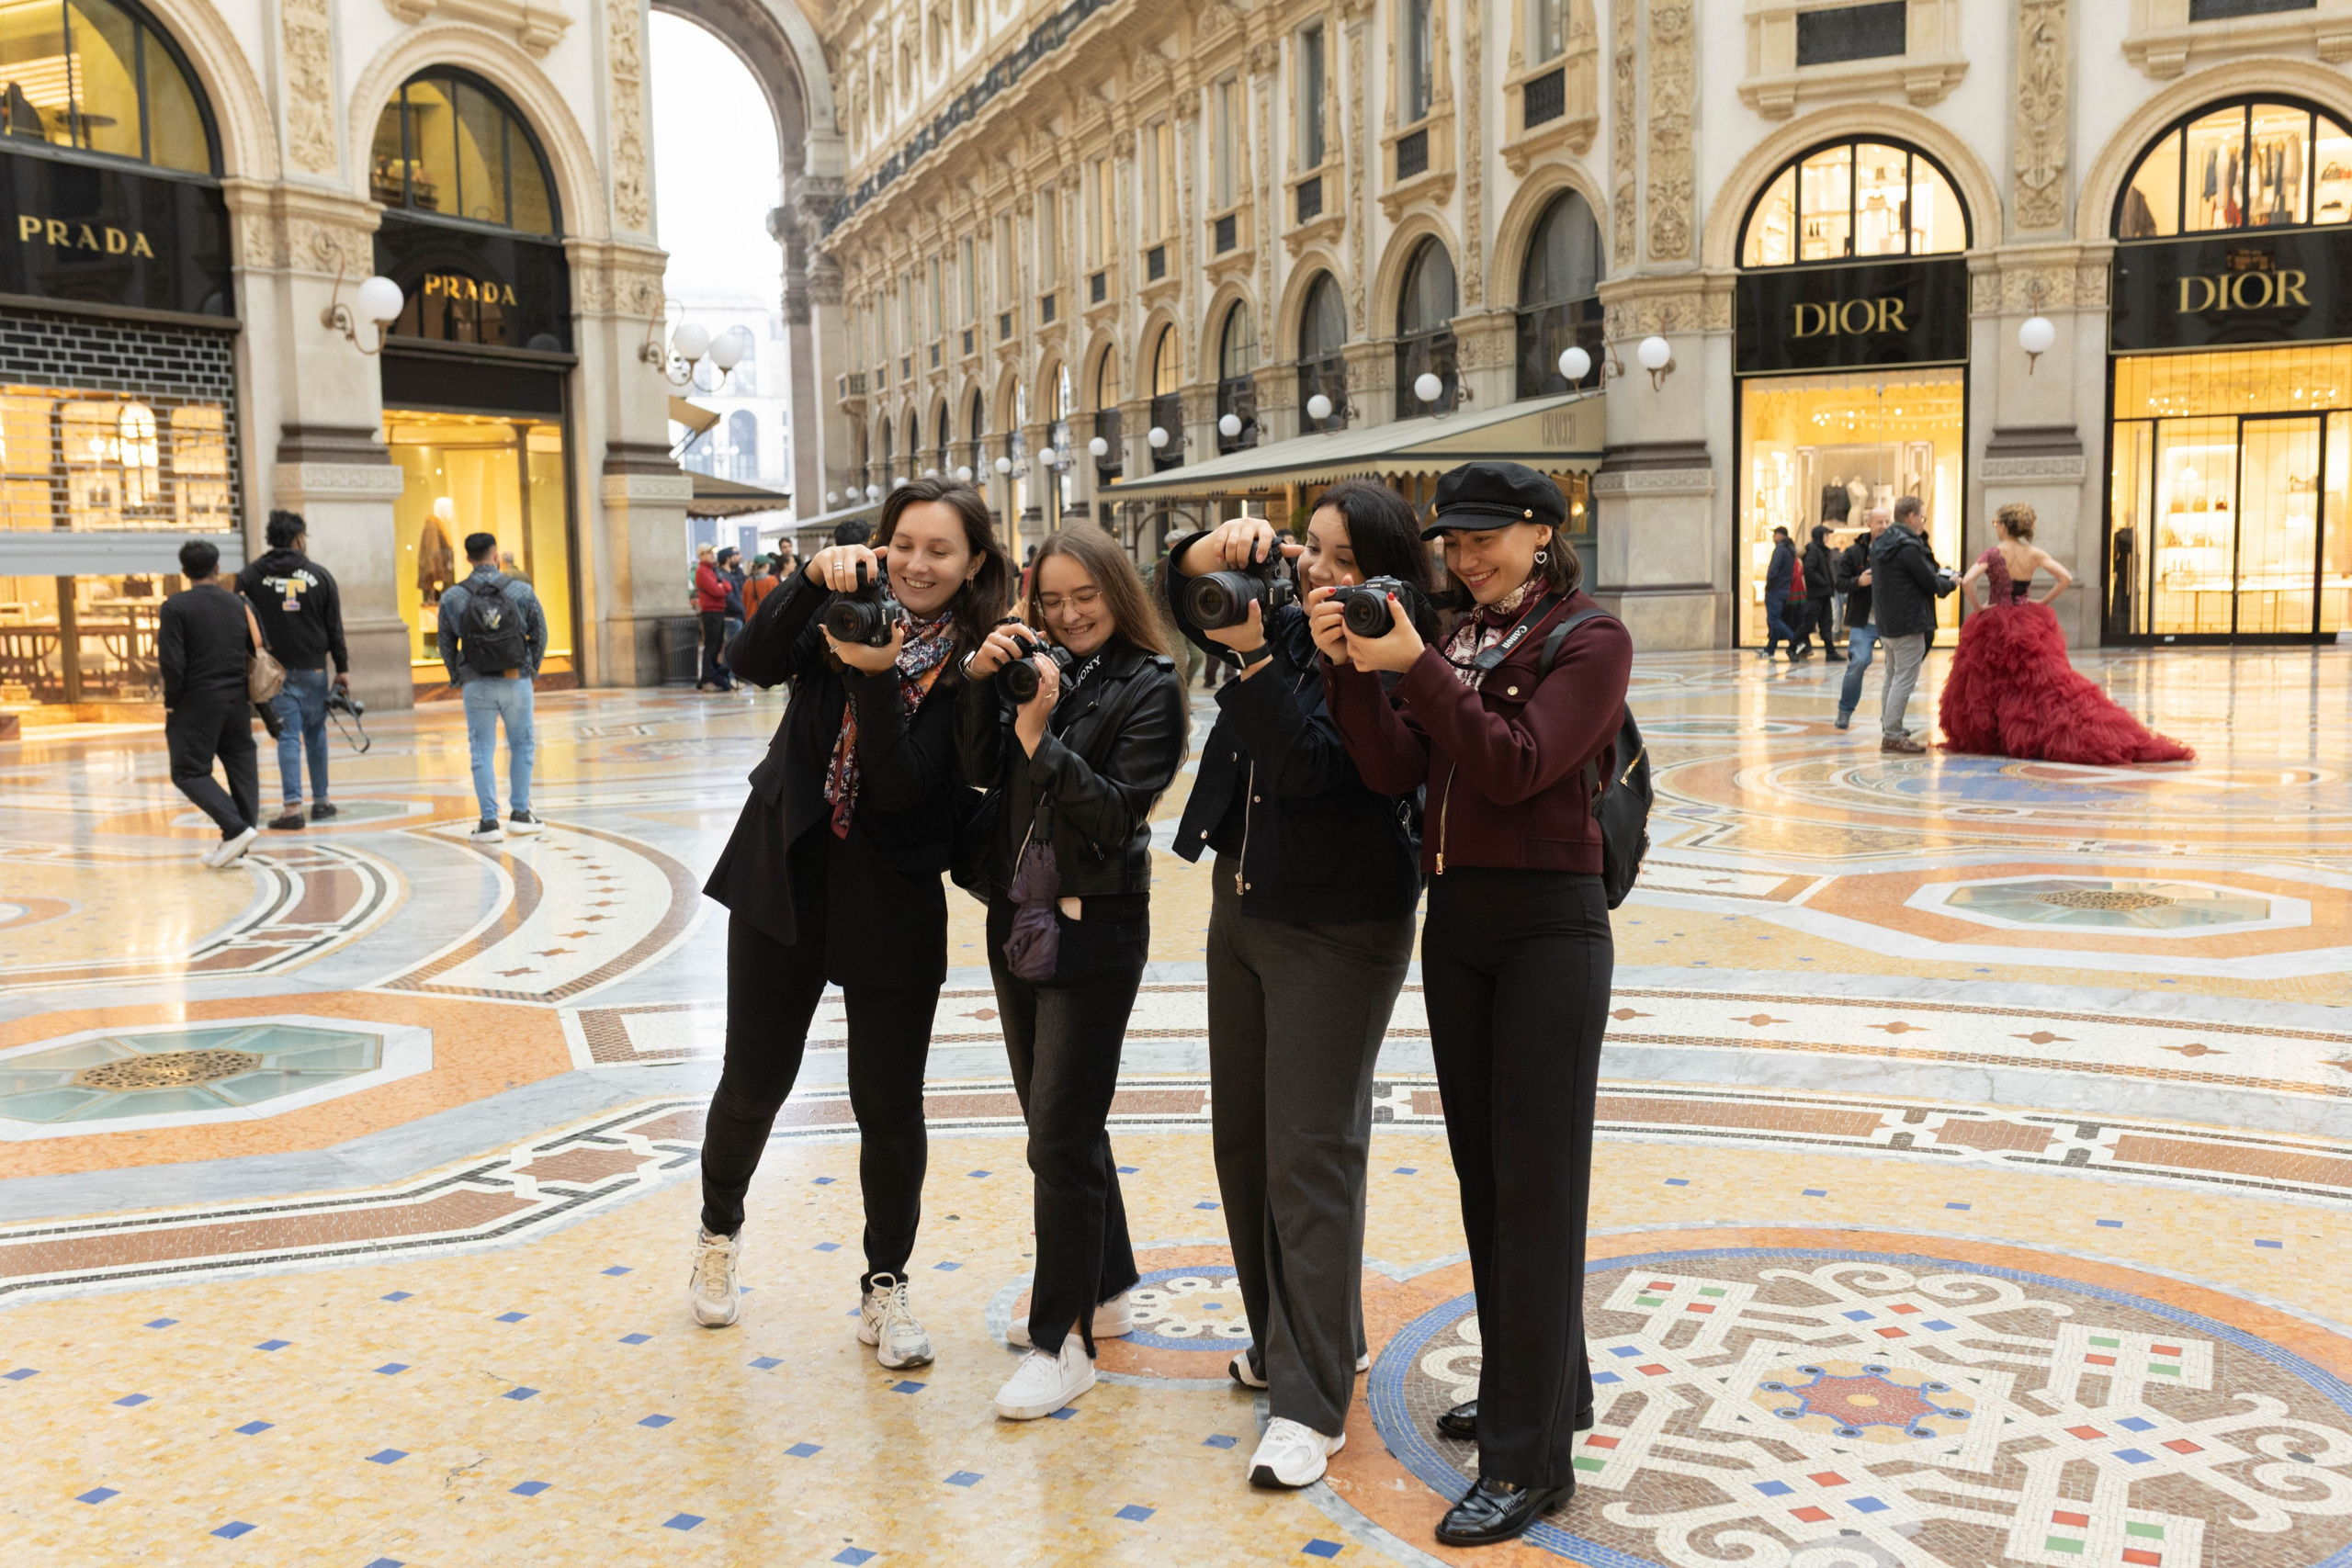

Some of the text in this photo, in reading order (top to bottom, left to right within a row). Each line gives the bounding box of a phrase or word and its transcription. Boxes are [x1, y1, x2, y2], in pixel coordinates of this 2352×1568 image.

[17, 214, 155, 259] PRADA
[424, 273, 517, 307] PRADA
[2176, 269, 2312, 313] DIOR
[1792, 297, 1909, 338] DIOR
[1501, 625, 1529, 649] Canon
[1049, 653, 1061, 667] SONY
[1077, 654, 1102, 687] SONY
